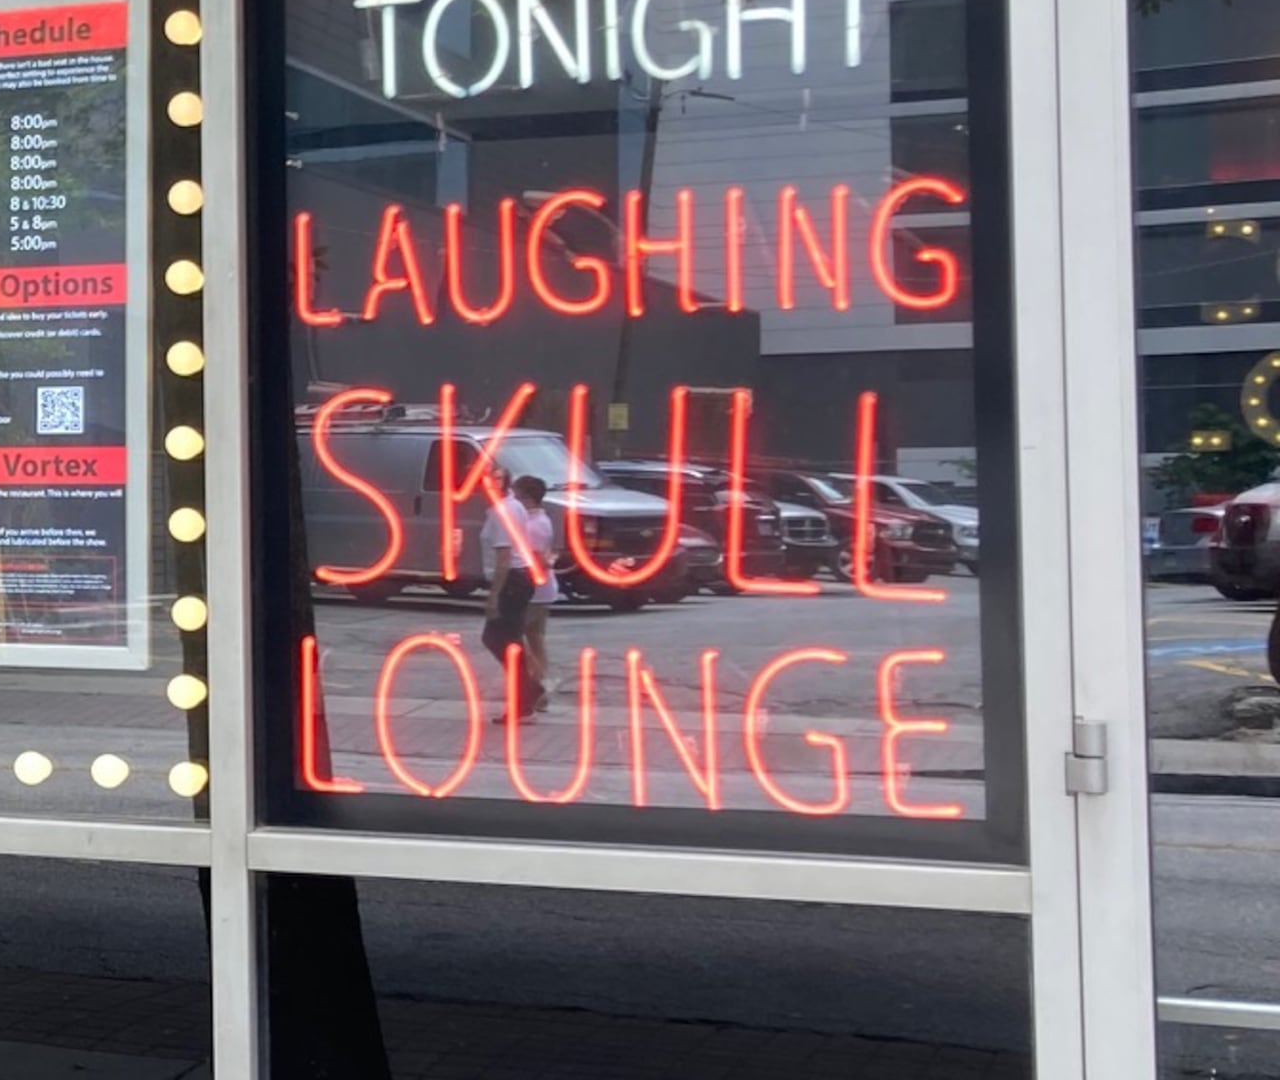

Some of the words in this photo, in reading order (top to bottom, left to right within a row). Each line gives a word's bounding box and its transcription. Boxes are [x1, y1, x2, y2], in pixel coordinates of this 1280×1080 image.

[10, 196, 20, 210] 8
[32, 195, 66, 210] 10:30
[10, 217, 19, 231] 5
[295, 177, 965, 326] LAUGHING
[1, 274, 113, 298] Options
[3, 455, 97, 476] Vortex
[313, 383, 947, 602] SKULL
[300, 633, 962, 817] LOUNGE
